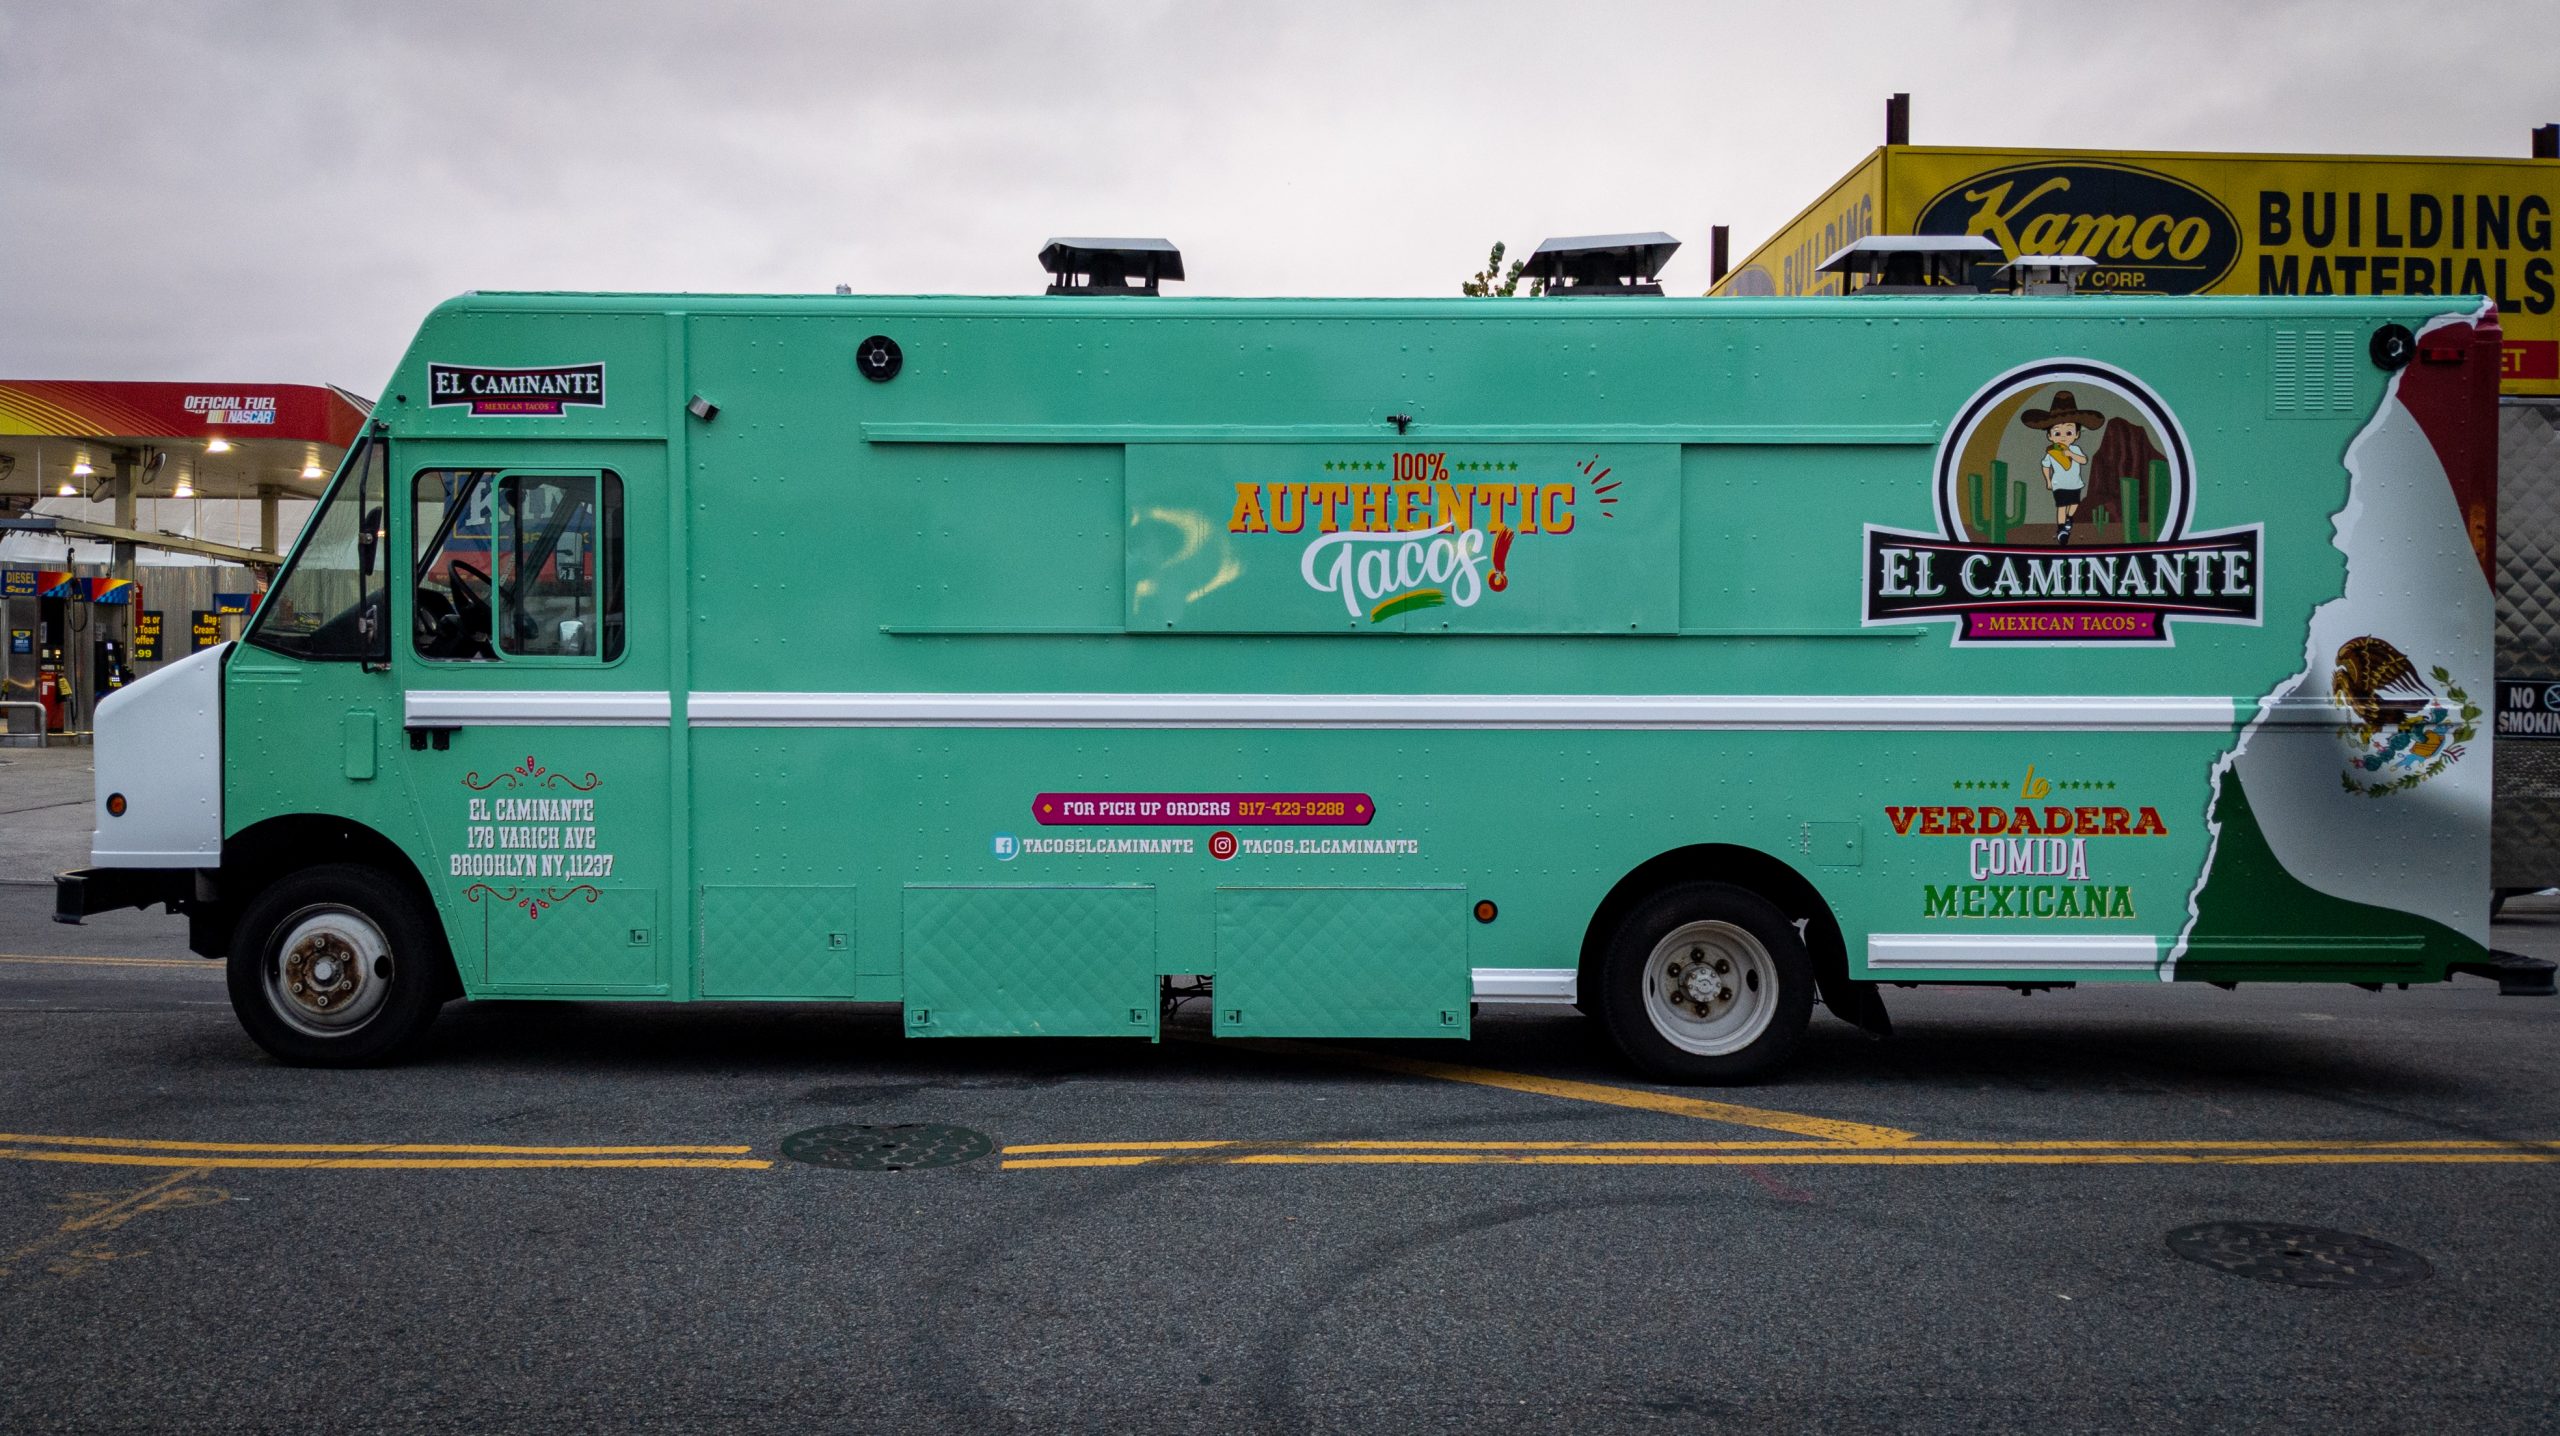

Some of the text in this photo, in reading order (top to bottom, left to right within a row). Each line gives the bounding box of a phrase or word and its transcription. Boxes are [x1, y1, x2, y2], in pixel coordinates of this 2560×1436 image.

[1965, 177, 2211, 261] Kamco
[2259, 191, 2552, 251] BUILDING
[2259, 255, 2555, 314] MATERIALS
[436, 372, 599, 394] EL CAMINANTE
[184, 395, 277, 410] OFFICIAL FUEL
[484, 402, 550, 410] MEXICAN TACOS
[228, 410, 275, 424] NASCAR
[1392, 453, 1448, 481] 100%
[1227, 482, 1576, 535] AUTHENTIC
[6, 571, 36, 584] DIESEL
[1878, 547, 2253, 597] EL CAMINANTE
[139, 625, 160, 634] Toast
[152, 616, 161, 624] or
[1989, 616, 2136, 631] MEXICAN TACOS
[135, 634, 155, 645] offee
[199, 635, 212, 645] and
[2510, 687, 2535, 709] NO
[2497, 710, 2560, 733] SMOKIN
[2020, 763, 2051, 799] La
[469, 799, 594, 821] EL CAMINANTE
[1063, 802, 1345, 816] FOR PICK UP ORDERS 917-423-9288
[1885, 806, 2169, 836] VERDADERA
[467, 826, 596, 849] 178 VARICH AVE
[1023, 839, 1194, 853] TACOSELCAMINANTE
[1242, 839, 1418, 854] TACOS.ELCAMINANTE
[450, 854, 538, 877] BROOKLYN
[1970, 837, 2090, 881] COMIDA
[1923, 884, 2136, 919] MEXICANA
